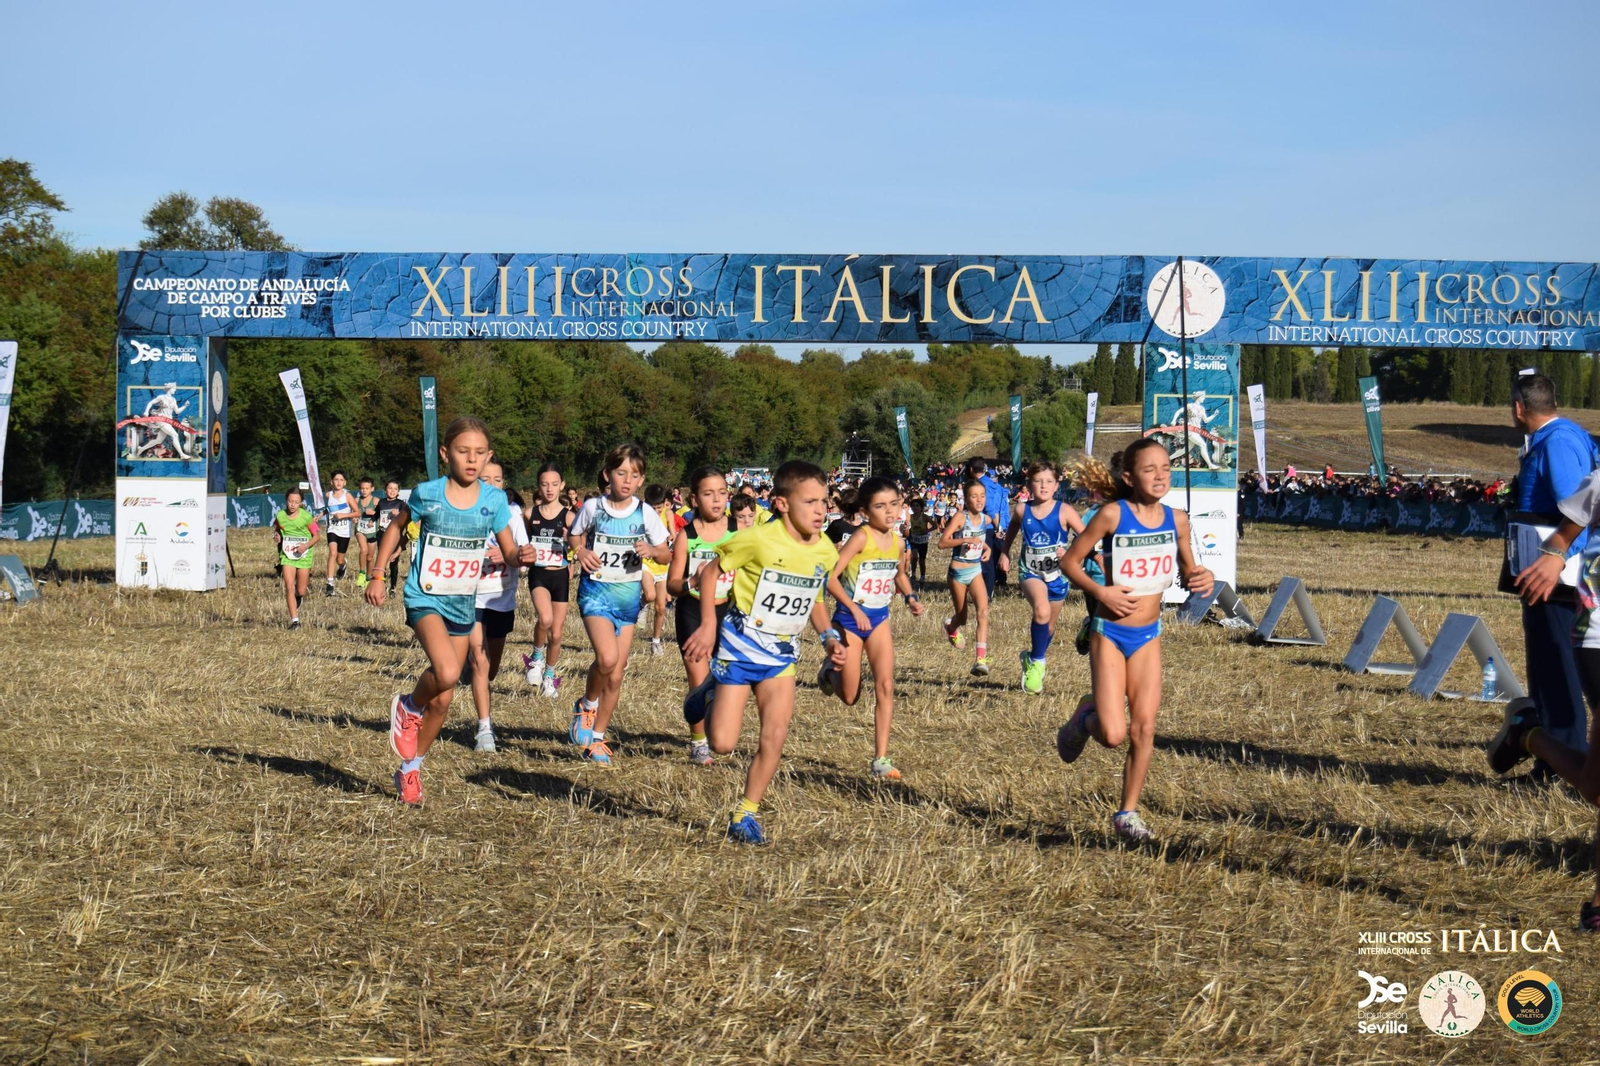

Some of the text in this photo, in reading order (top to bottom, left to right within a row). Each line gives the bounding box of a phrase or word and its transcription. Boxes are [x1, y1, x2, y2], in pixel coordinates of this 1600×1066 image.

[133, 276, 350, 292] CAMPEONATO DE ANDALUCÍA
[410, 265, 694, 317] XLIII CROSS
[750, 254, 1052, 325] ITÁLICA
[167, 289, 317, 305] DE CAMPO A TRAVÉS
[1269, 269, 1561, 324] XLIII CROSS
[201, 306, 287, 318] POR CLUBES
[571, 300, 738, 317] INTERNACIONAL
[410, 321, 709, 337] INTERNATIONAL CROSS COUNTRY
[1268, 326, 1576, 347] INTERNATIONAL CROSS COUNTRY
[164, 353, 197, 363] Sevilla
[1193, 361, 1227, 370] Sevilla
[92, 521, 111, 535] Sevilla
[444, 539, 475, 549] ITÁLICA
[1132, 536, 1163, 546] ITÁLICA
[537, 549, 563, 562] 375
[600, 551, 641, 568] 4278
[427, 558, 480, 579] 4379
[1120, 554, 1173, 579] 4370
[781, 575, 811, 587] ITÁLICA
[861, 578, 891, 595] 436
[761, 593, 812, 617] 4293
